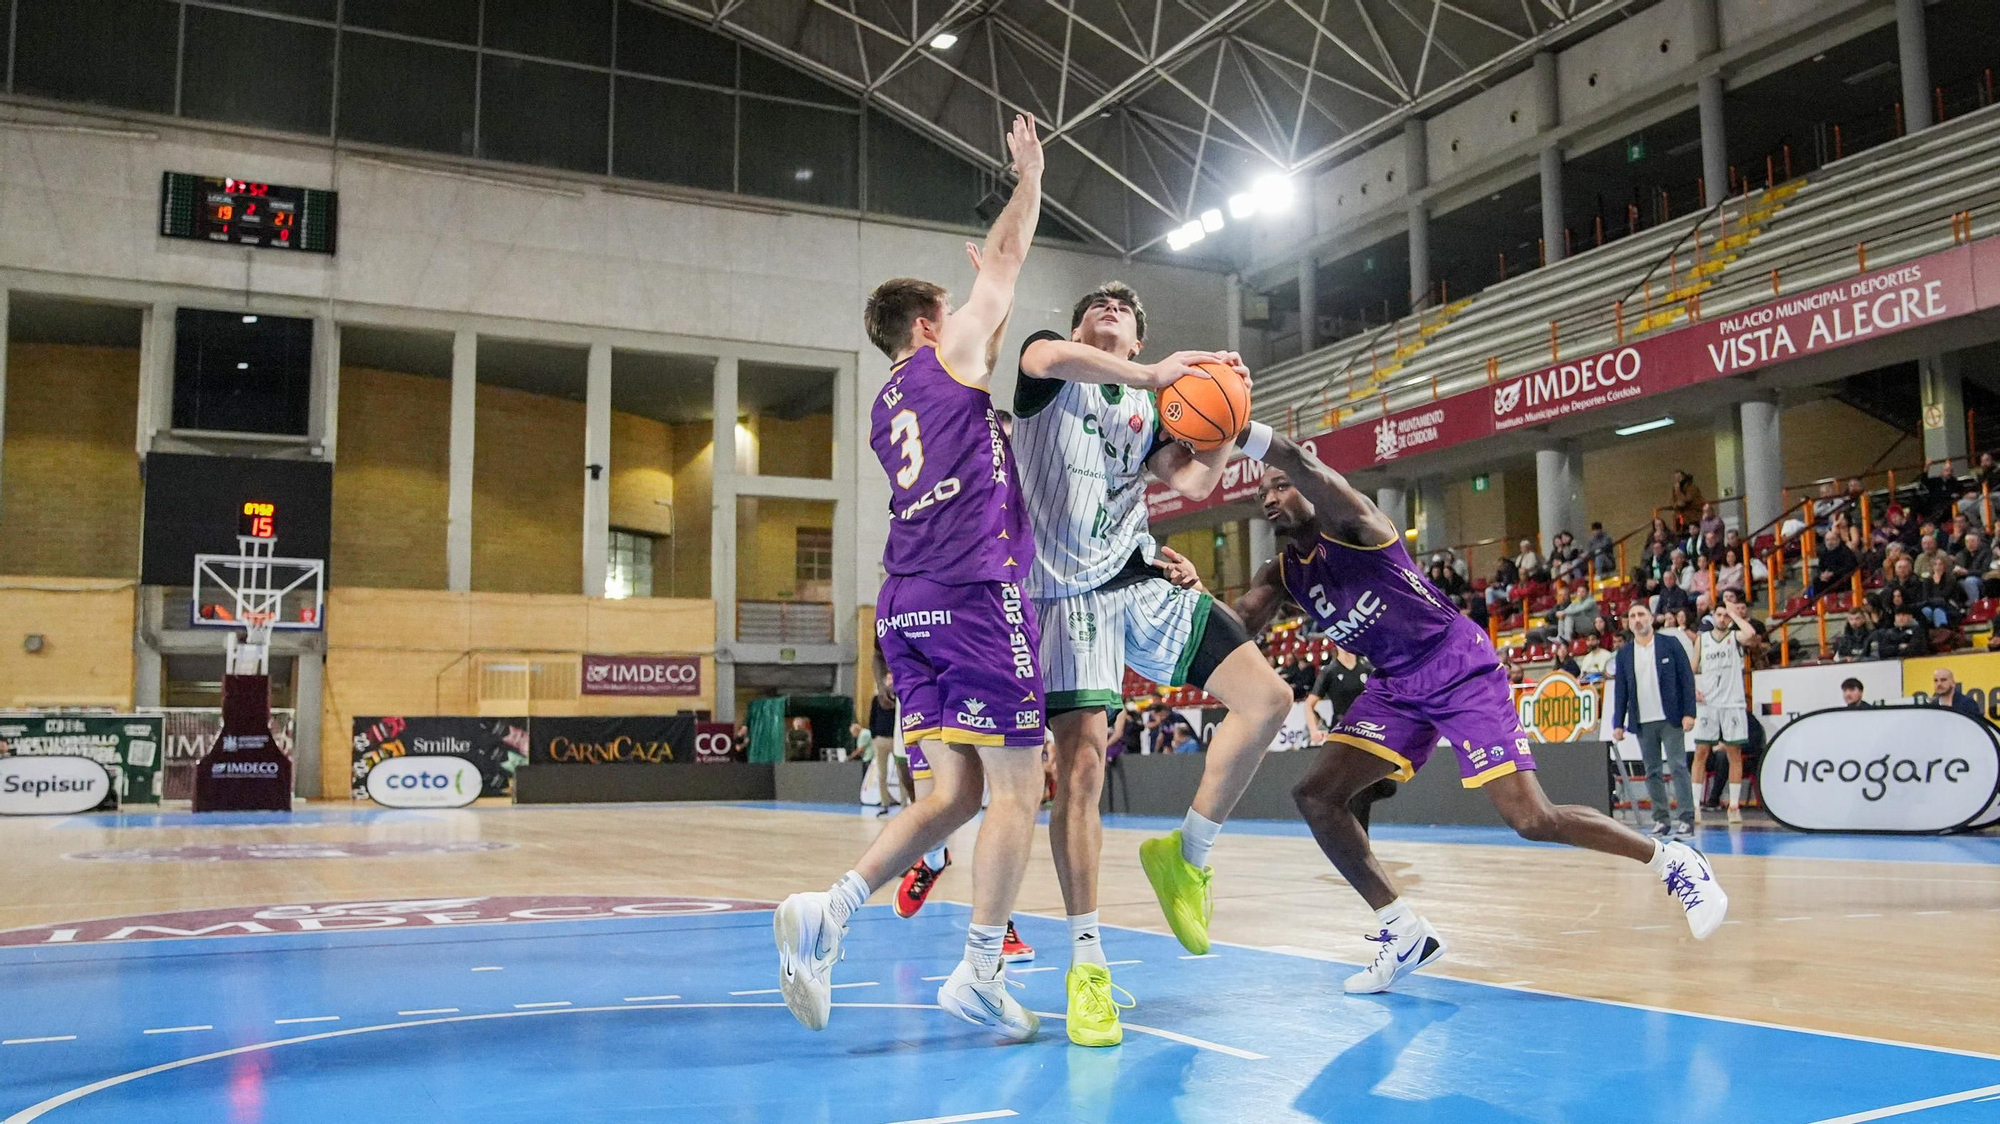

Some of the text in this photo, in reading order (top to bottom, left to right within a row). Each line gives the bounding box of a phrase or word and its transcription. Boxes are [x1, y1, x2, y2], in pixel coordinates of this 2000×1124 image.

[218, 205, 233, 220] 19
[274, 210, 293, 226] 21
[1719, 265, 1922, 335] PALACIO MUNICIPAL DEPORTES
[1707, 279, 1947, 373] VISTA ALEGRE
[1525, 347, 1641, 407] IMDECO
[1495, 386, 1642, 430] Instituto Municipal de Deportes Córdoba
[1397, 409, 1445, 434] AYUNTAMIENTO
[889, 408, 925, 490] 3
[252, 517, 273, 538] 15
[1309, 583, 1336, 619] 2
[612, 664, 697, 684] IMDECO
[957, 711, 997, 729] CRZA
[1016, 710, 1040, 724] CBC
[1344, 725, 1386, 741] HYUNDAI
[413, 736, 471, 754] Smilke
[227, 762, 279, 774] IMDECO
[1783, 754, 1970, 802] neogare
[4, 775, 96, 799] Sepisur
[386, 771, 449, 789] coto
[41, 901, 733, 943] IMDECO
